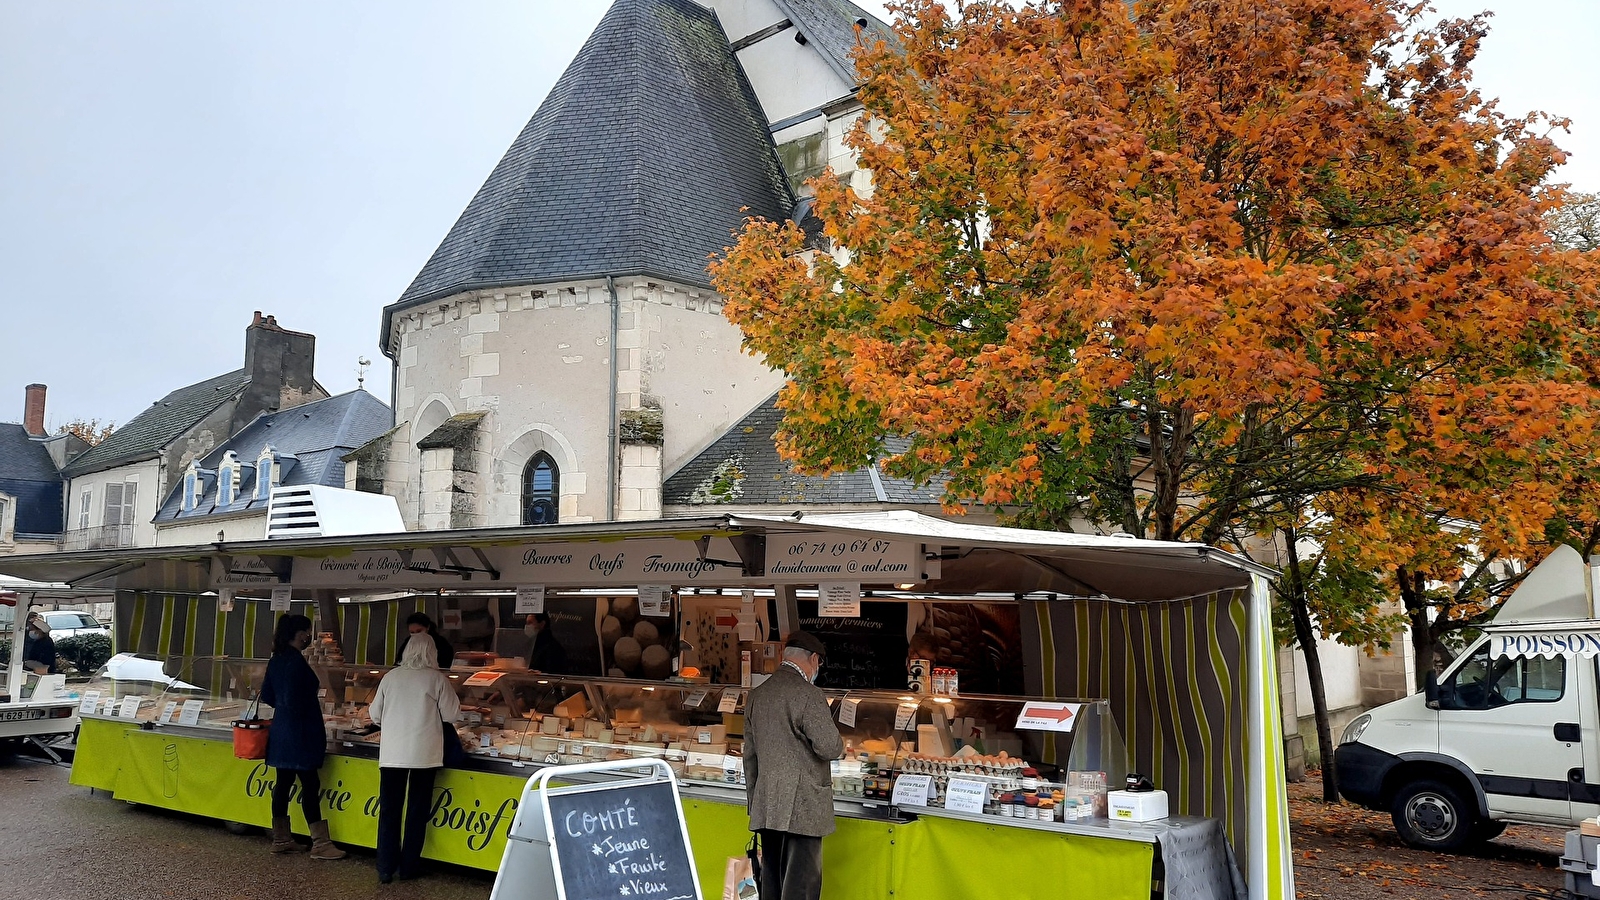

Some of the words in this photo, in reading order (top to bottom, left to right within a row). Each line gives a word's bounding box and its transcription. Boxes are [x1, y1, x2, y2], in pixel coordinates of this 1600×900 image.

[788, 541, 807, 556] 06
[811, 542, 826, 556] 74
[830, 542, 846, 557] 19
[850, 538, 870, 553] 64
[872, 539, 890, 554] 87
[320, 558, 359, 571] Crèmerie
[362, 556, 374, 570] de
[522, 548, 573, 566] Beurres
[588, 552, 624, 576] Oeufs
[846, 559, 858, 573] @
[861, 558, 908, 572] aol.com
[643, 554, 716, 579] Fromages
[6, 712, 23, 720] 629
[565, 798, 639, 837] COMTÉ
[601, 835, 650, 857] Jeune
[629, 879, 667, 894] Vieux
